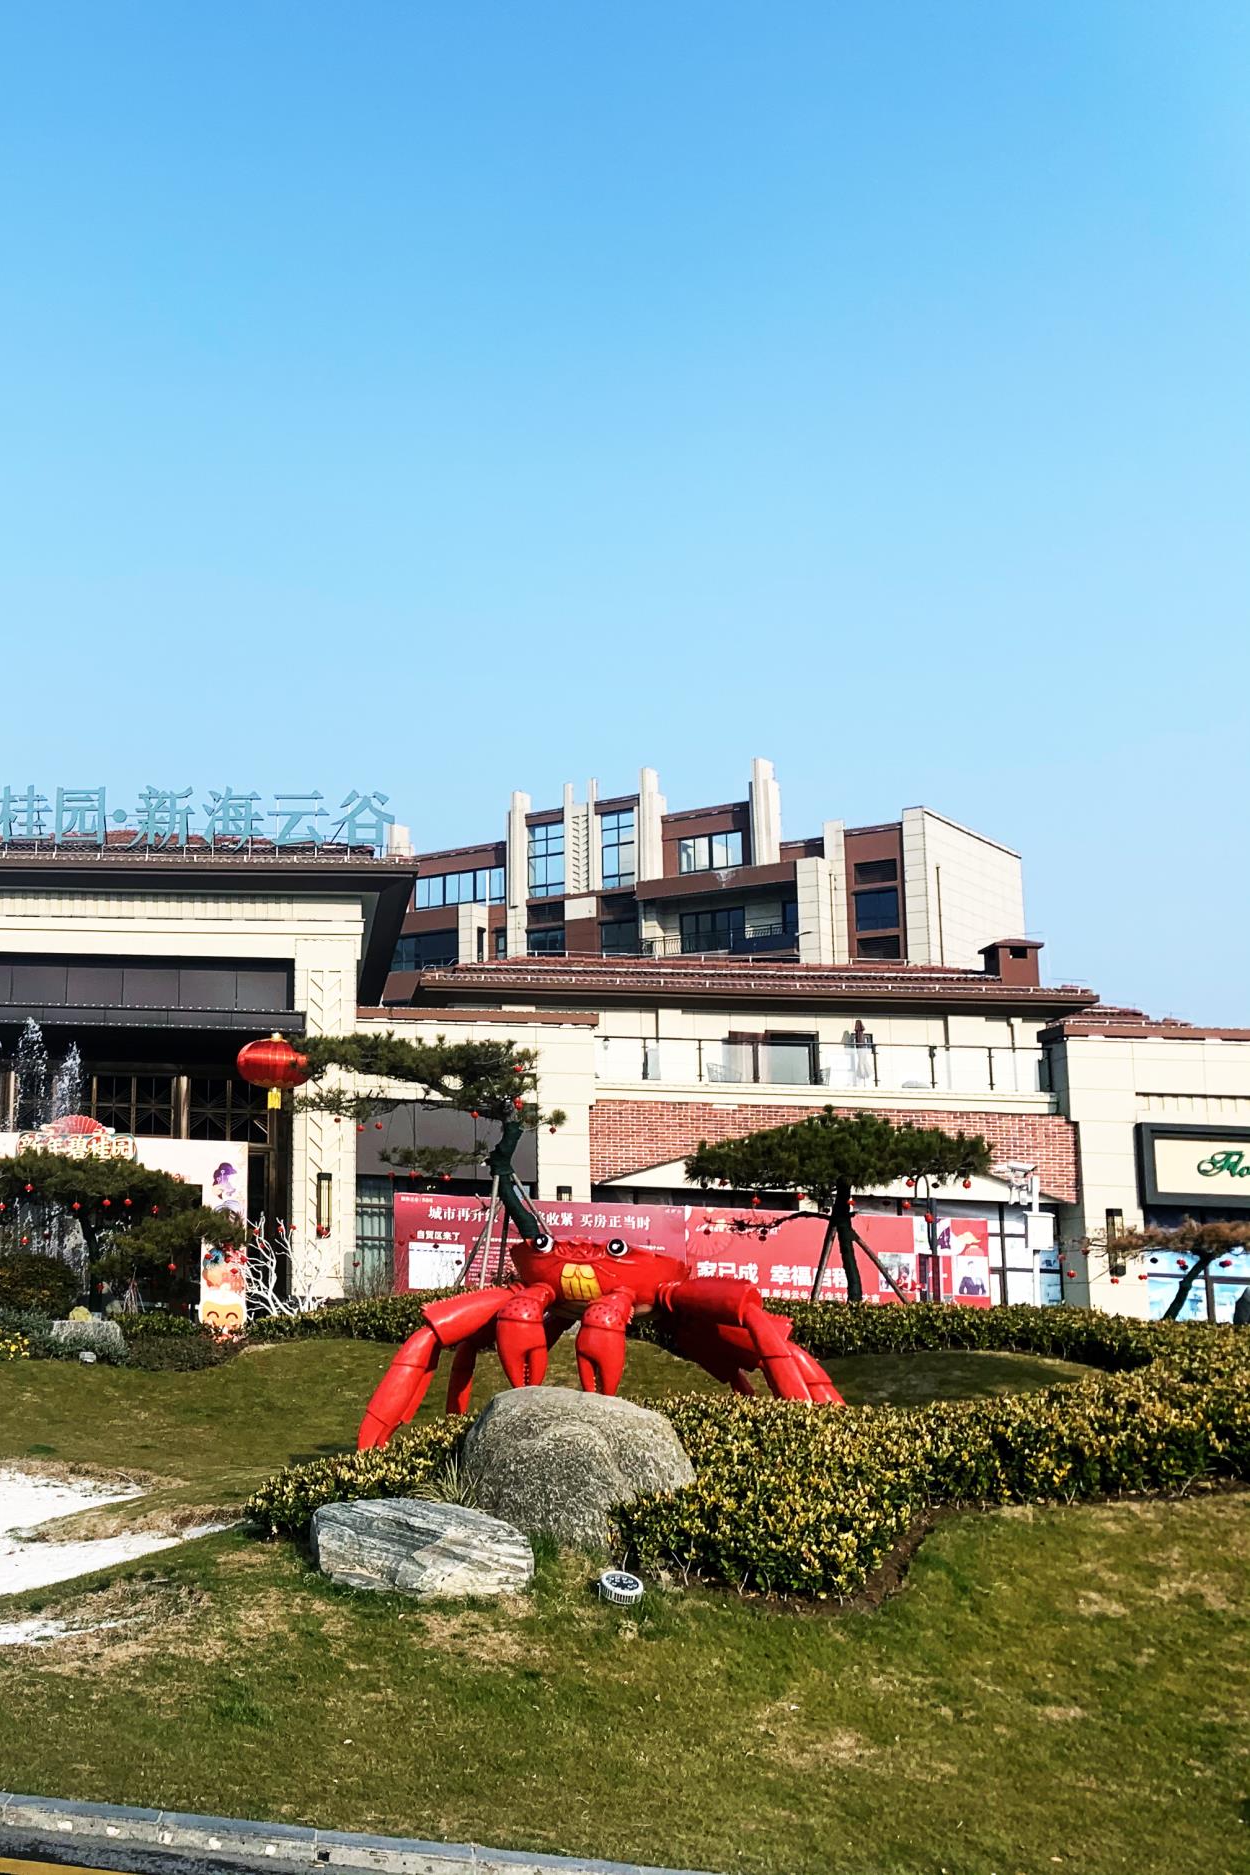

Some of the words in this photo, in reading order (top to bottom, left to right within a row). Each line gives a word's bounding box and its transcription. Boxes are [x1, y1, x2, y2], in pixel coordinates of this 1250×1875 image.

[580, 1213, 651, 1230] 买房正当时
[416, 1230, 460, 1241] 自贸区来了
[696, 1261, 759, 1284] 家已成
